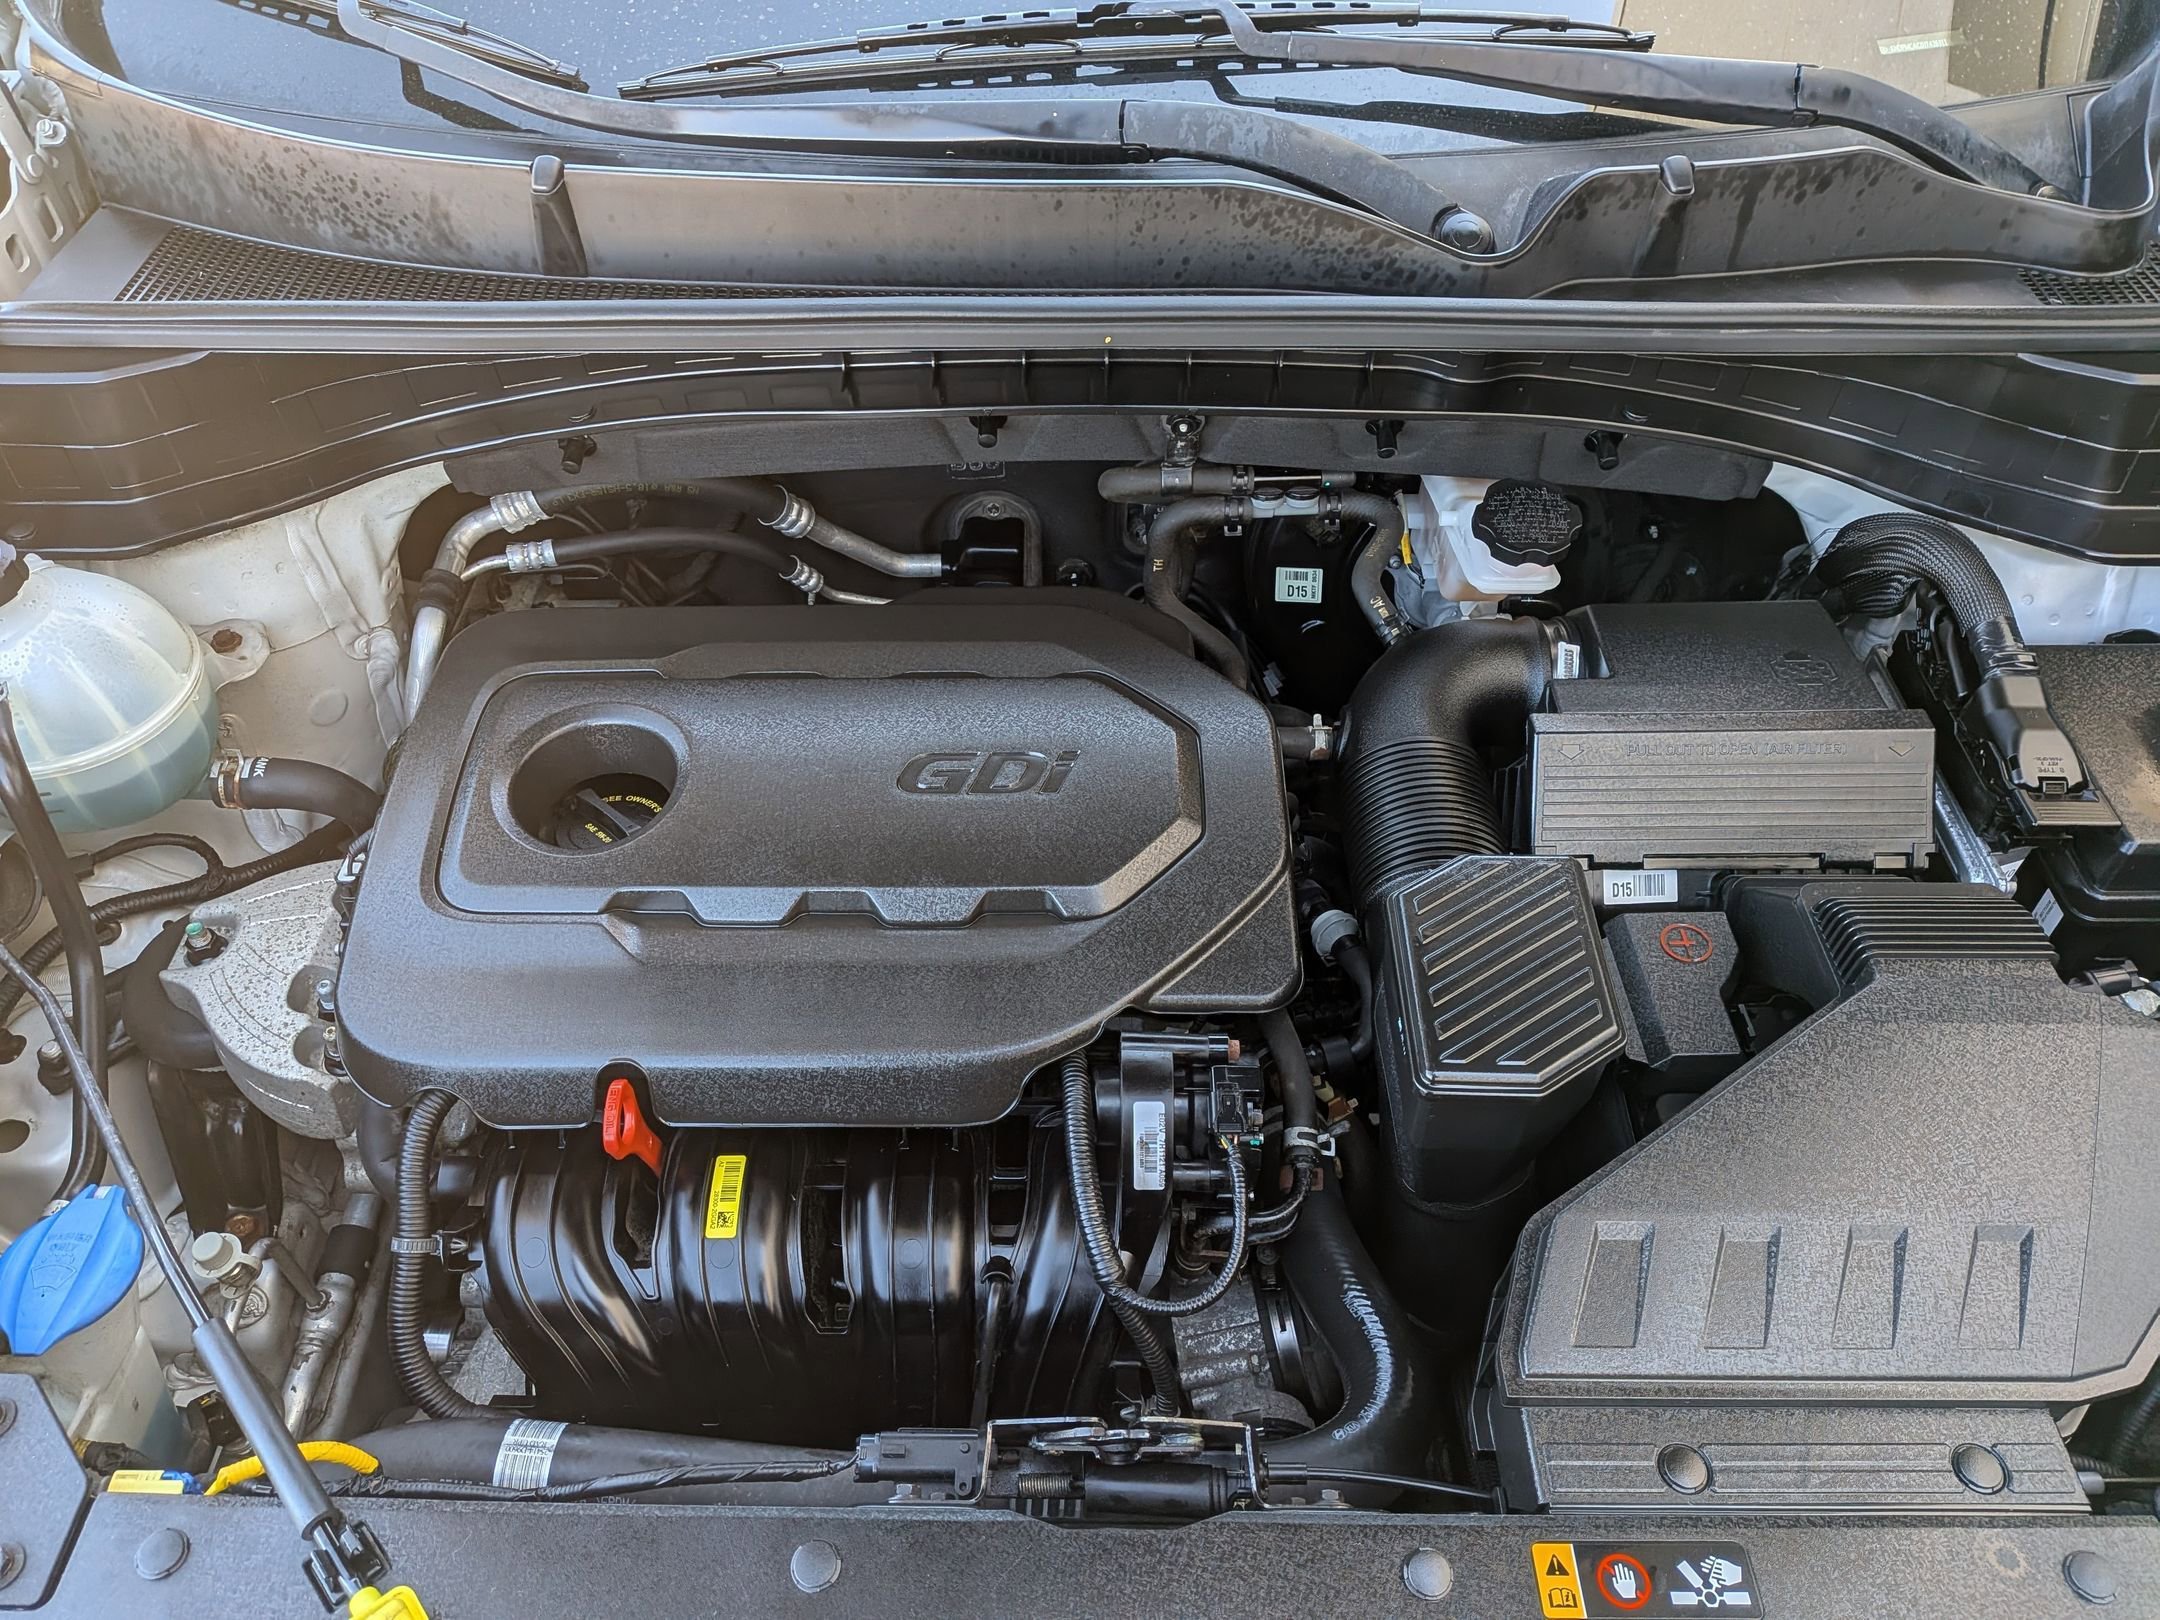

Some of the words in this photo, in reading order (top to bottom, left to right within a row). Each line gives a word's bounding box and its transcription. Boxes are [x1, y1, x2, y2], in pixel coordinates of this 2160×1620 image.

[1287, 585, 1308, 598] D15
[1626, 744, 1661, 757] PULL
[1665, 744, 1695, 756] OUT
[1699, 744, 1715, 756] TO
[1719, 743, 1758, 756] OPEN
[896, 750, 1081, 795] GDi
[1612, 882, 1632, 898] D15
